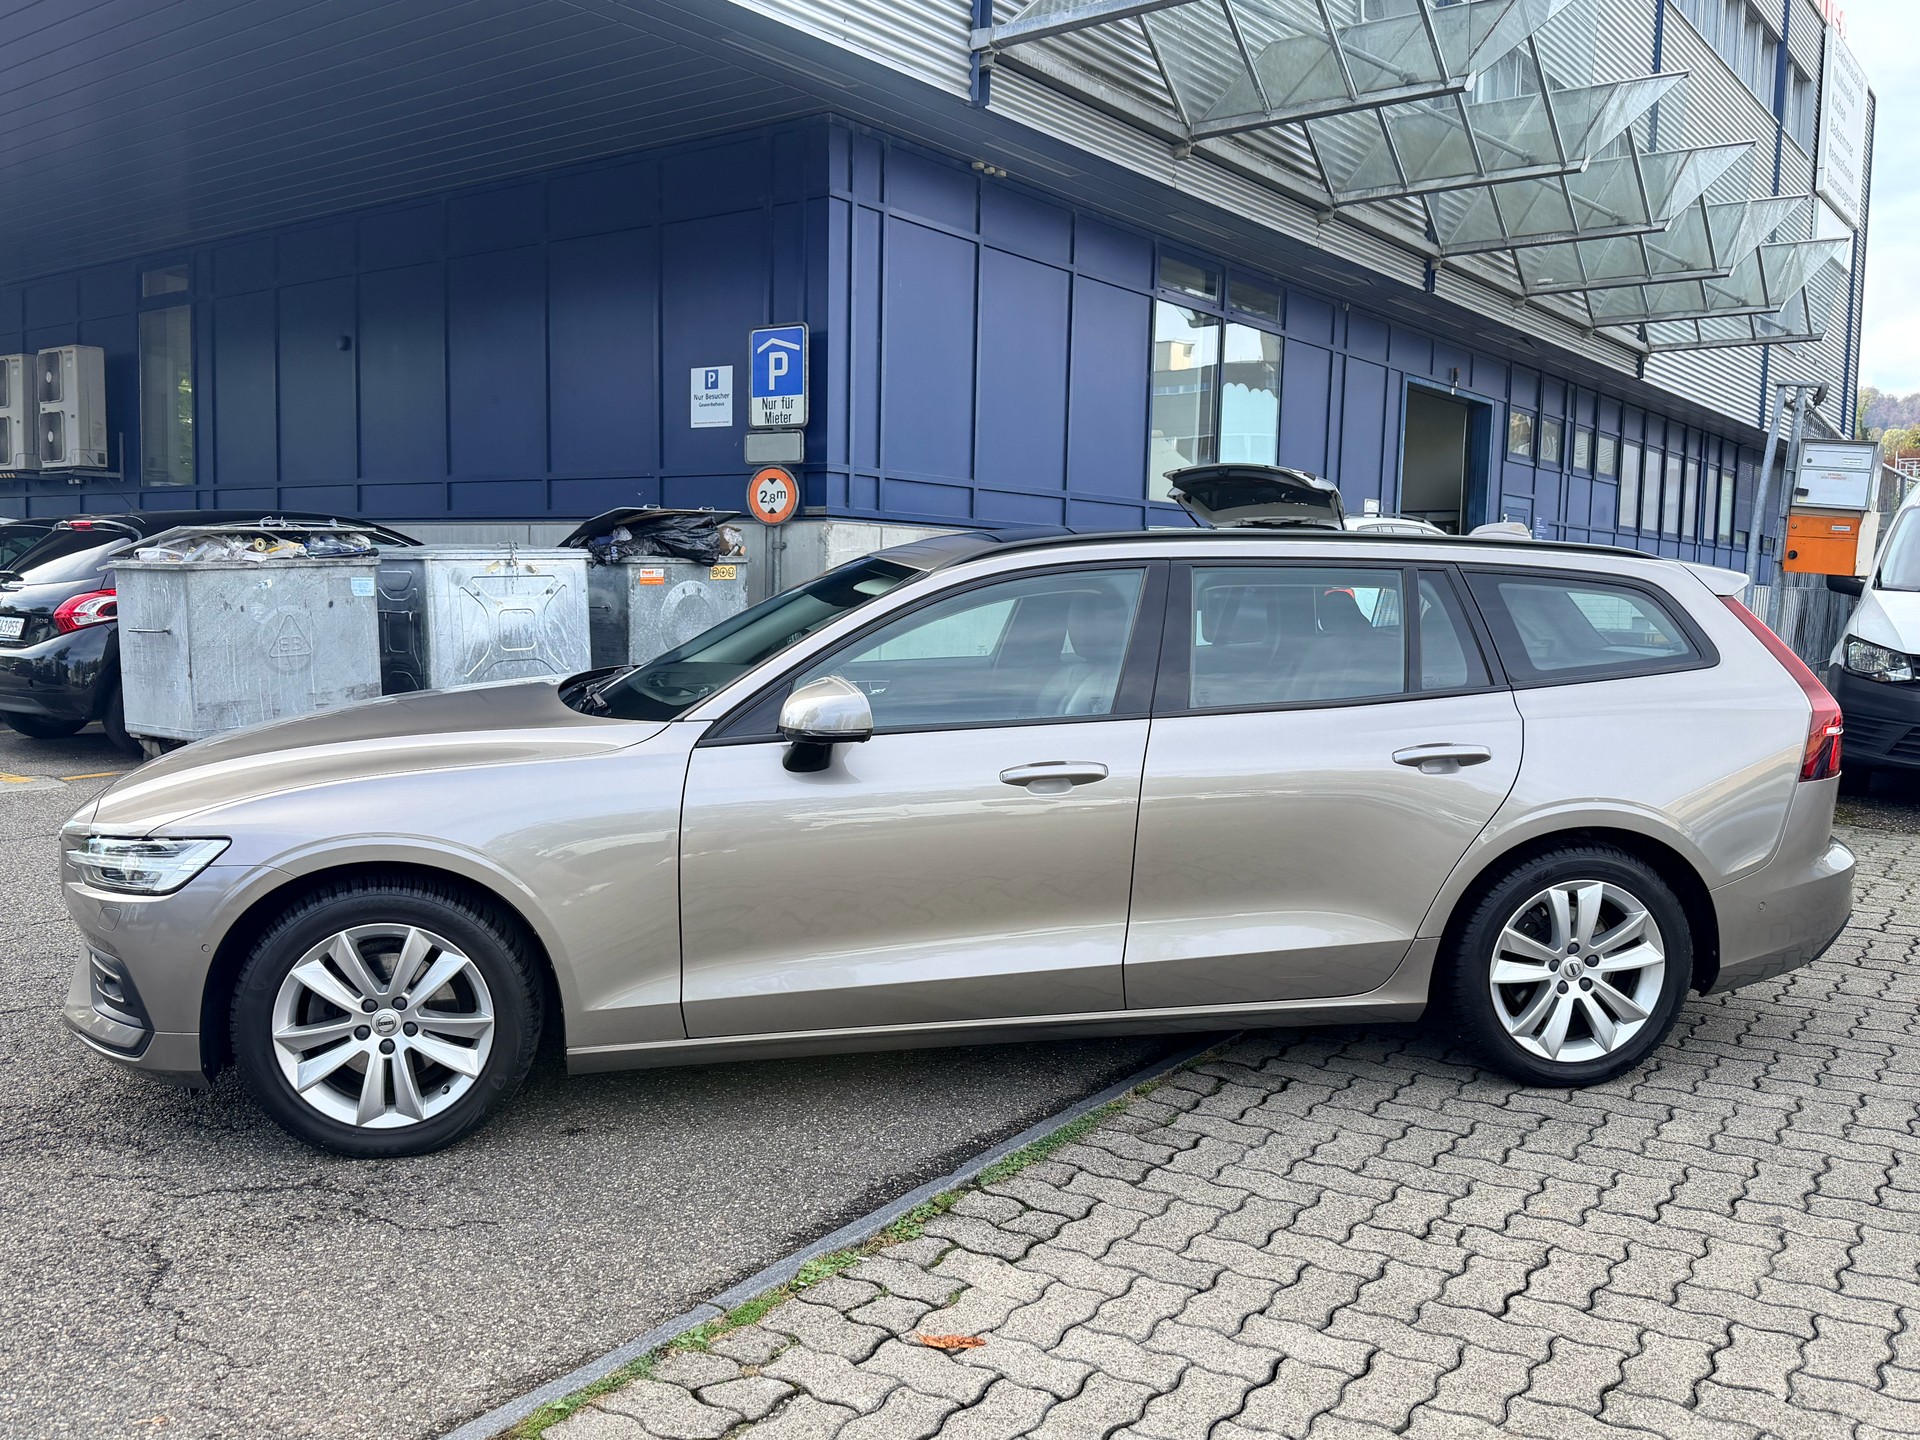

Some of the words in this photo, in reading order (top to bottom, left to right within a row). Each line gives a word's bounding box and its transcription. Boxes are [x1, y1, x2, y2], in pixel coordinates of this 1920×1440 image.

[768, 351, 789, 391] P
[708, 372, 716, 388] P
[705, 392, 730, 400] Besucher
[761, 397, 777, 411] Nur
[781, 397, 794, 409] für
[764, 411, 792, 424] Mieter
